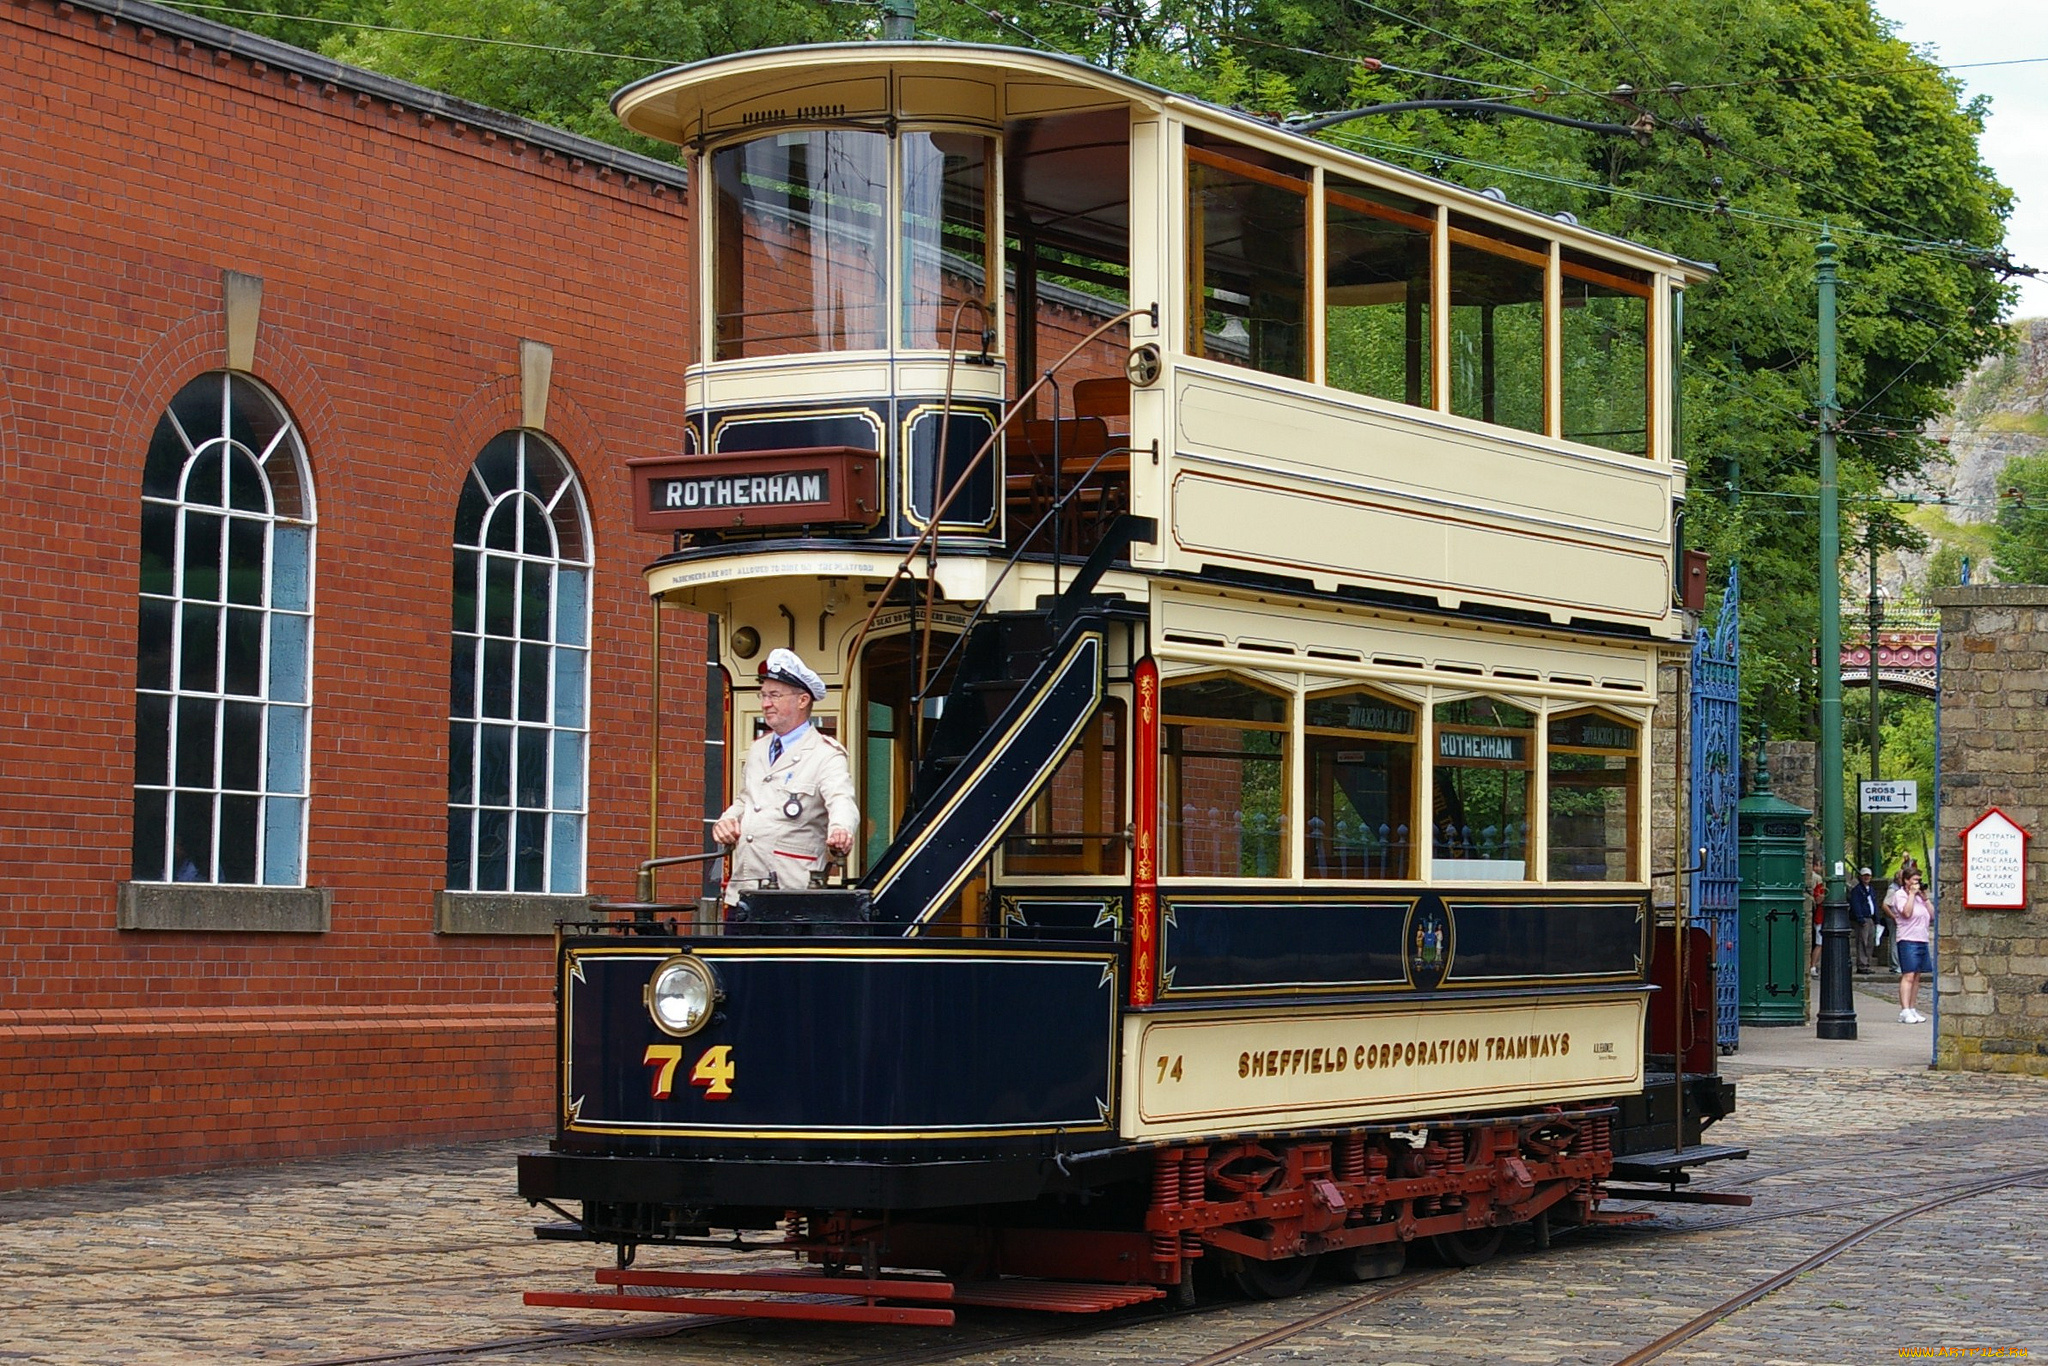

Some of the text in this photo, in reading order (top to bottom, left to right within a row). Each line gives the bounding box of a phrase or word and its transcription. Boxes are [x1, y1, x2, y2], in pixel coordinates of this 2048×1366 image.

[666, 475, 820, 507] ROTHERHAM
[834, 563, 874, 572] PLATFORM
[1440, 733, 1513, 760] ROTHERHAM
[1865, 786, 1896, 794] CROSS
[1156, 1055, 1183, 1084] 74
[1238, 1032, 1571, 1079] SHEFFIELD CORPORATION TRAMWAYS
[643, 1044, 735, 1100] 74
